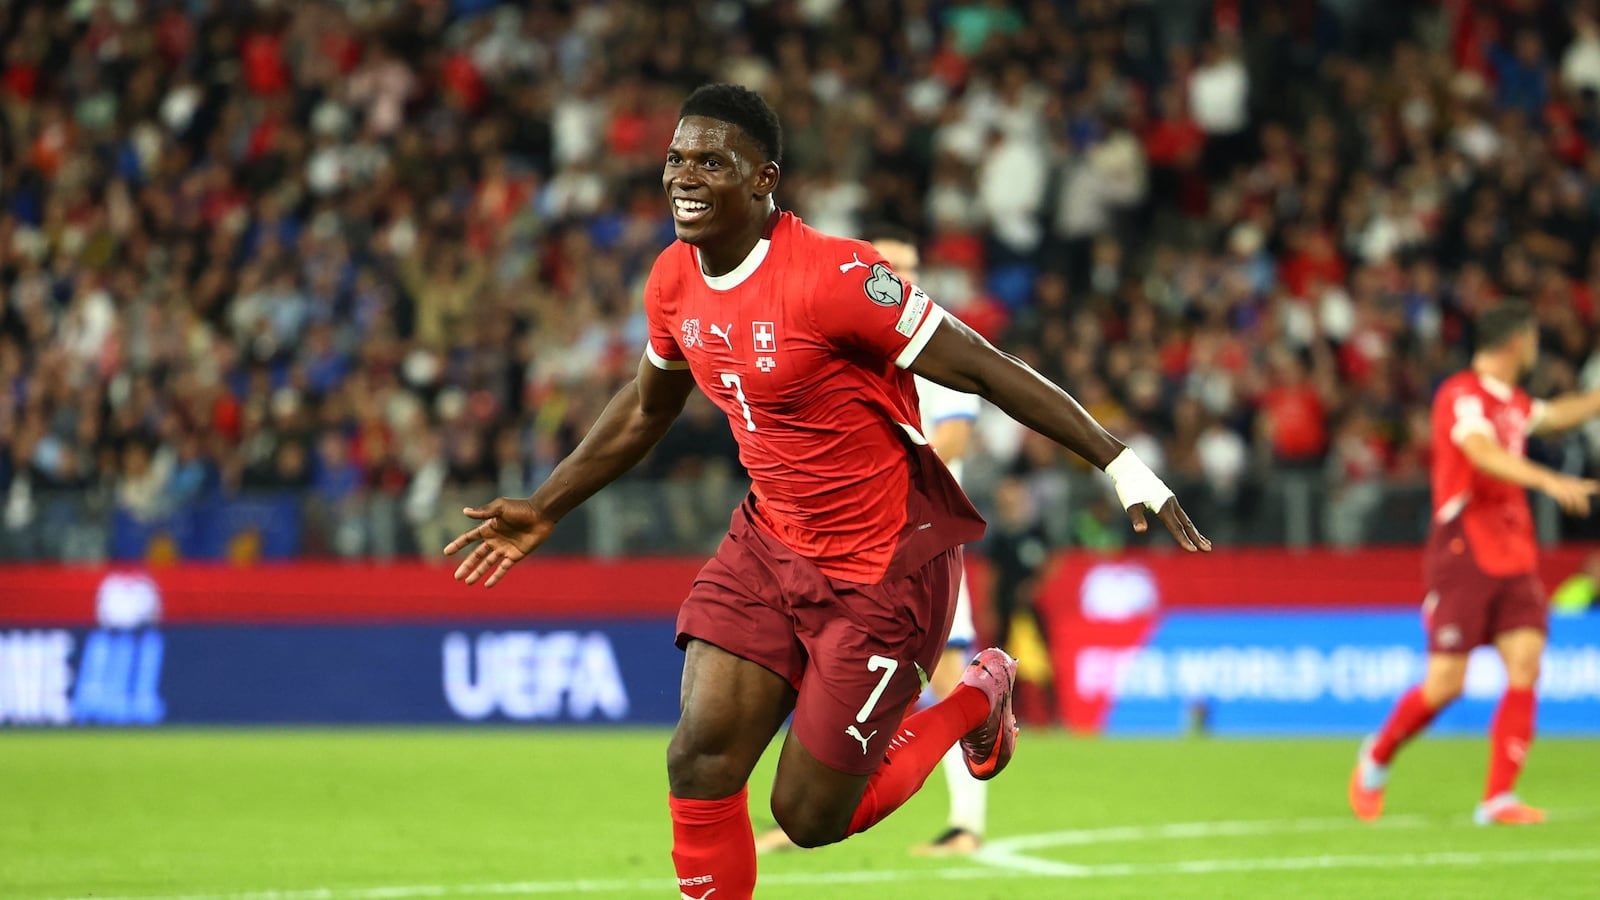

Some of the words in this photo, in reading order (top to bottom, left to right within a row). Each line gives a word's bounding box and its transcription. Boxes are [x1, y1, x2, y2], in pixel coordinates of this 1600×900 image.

[720, 373, 757, 432] 7
[442, 630, 630, 719] UEFA
[856, 655, 898, 723] 7
[1177, 647, 1323, 701] WORLD
[1330, 646, 1420, 700] CUP
